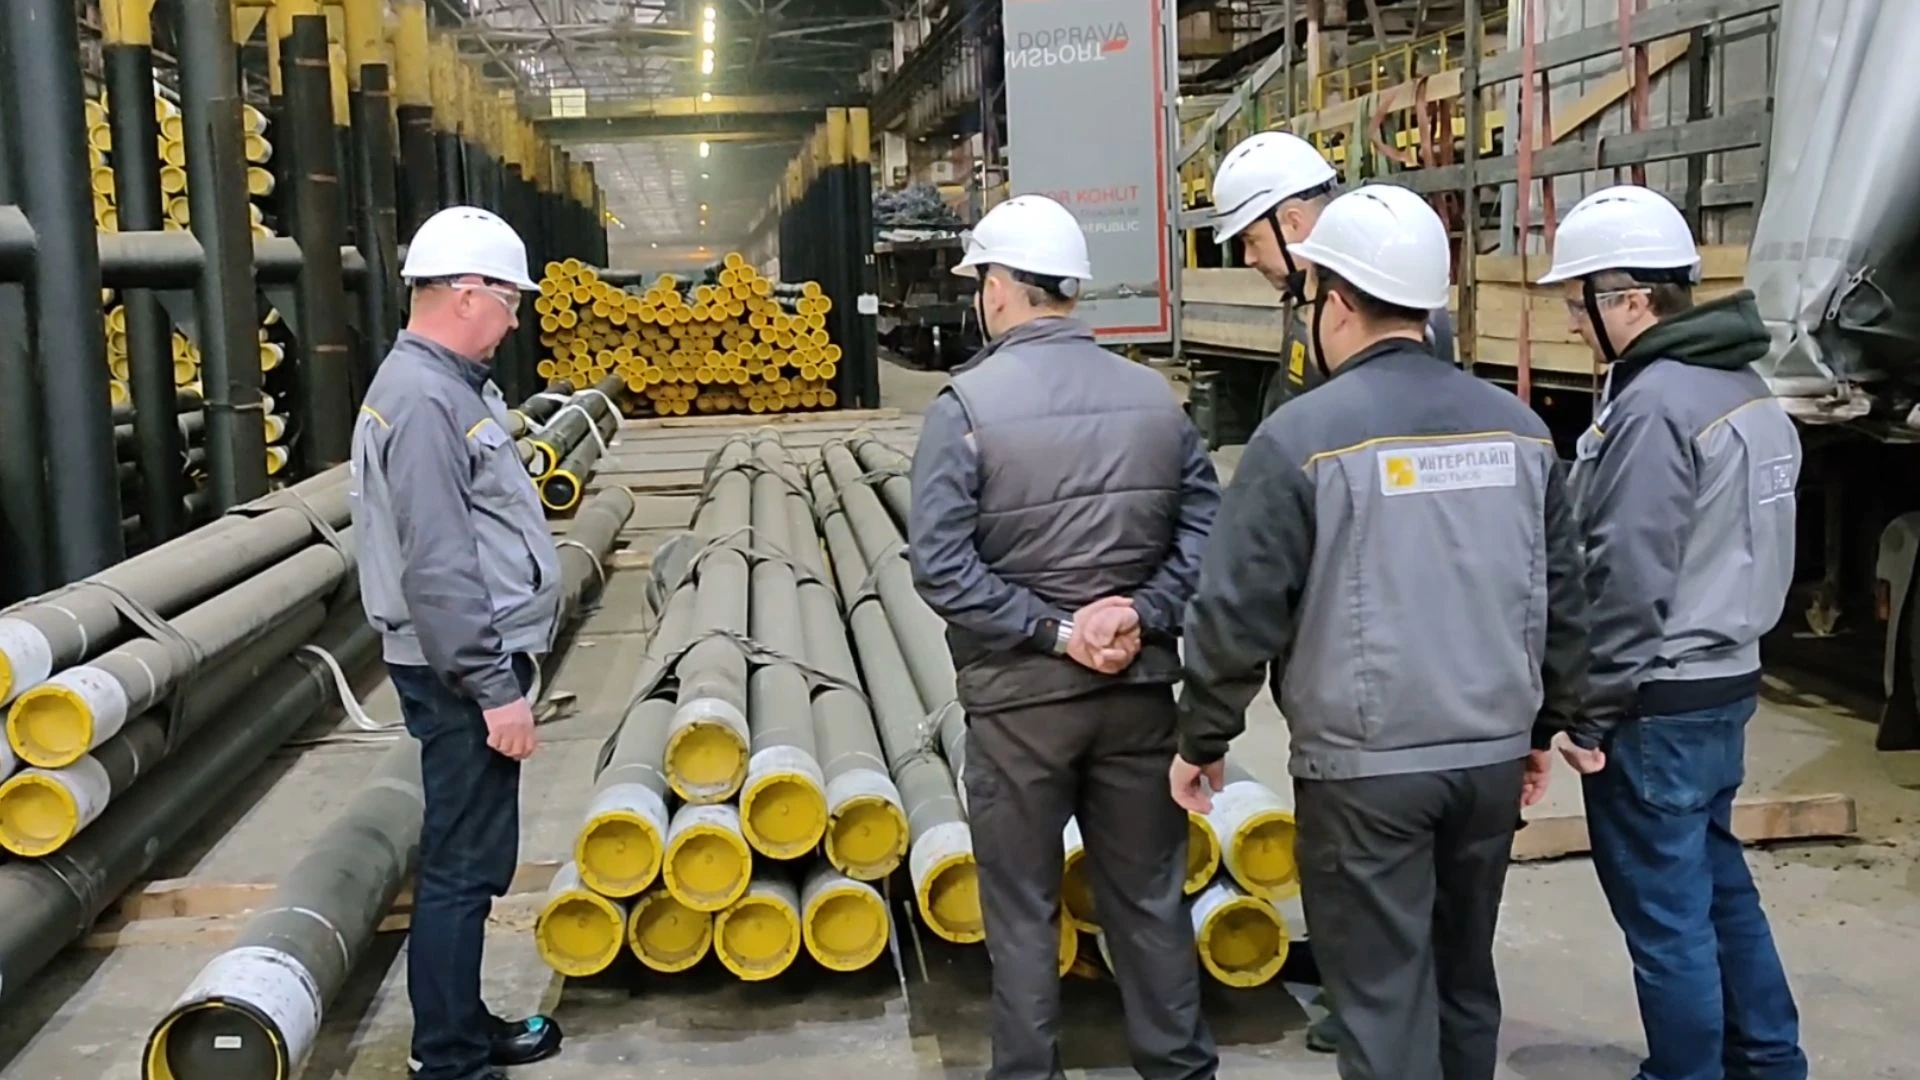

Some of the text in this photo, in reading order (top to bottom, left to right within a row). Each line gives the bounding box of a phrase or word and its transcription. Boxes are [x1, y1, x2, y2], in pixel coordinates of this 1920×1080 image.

[1018, 21, 1129, 49] DOPRAVA
[1076, 185, 1139, 203] KOHUT
[1418, 447, 1509, 471] ИНТЕРПАЙП
